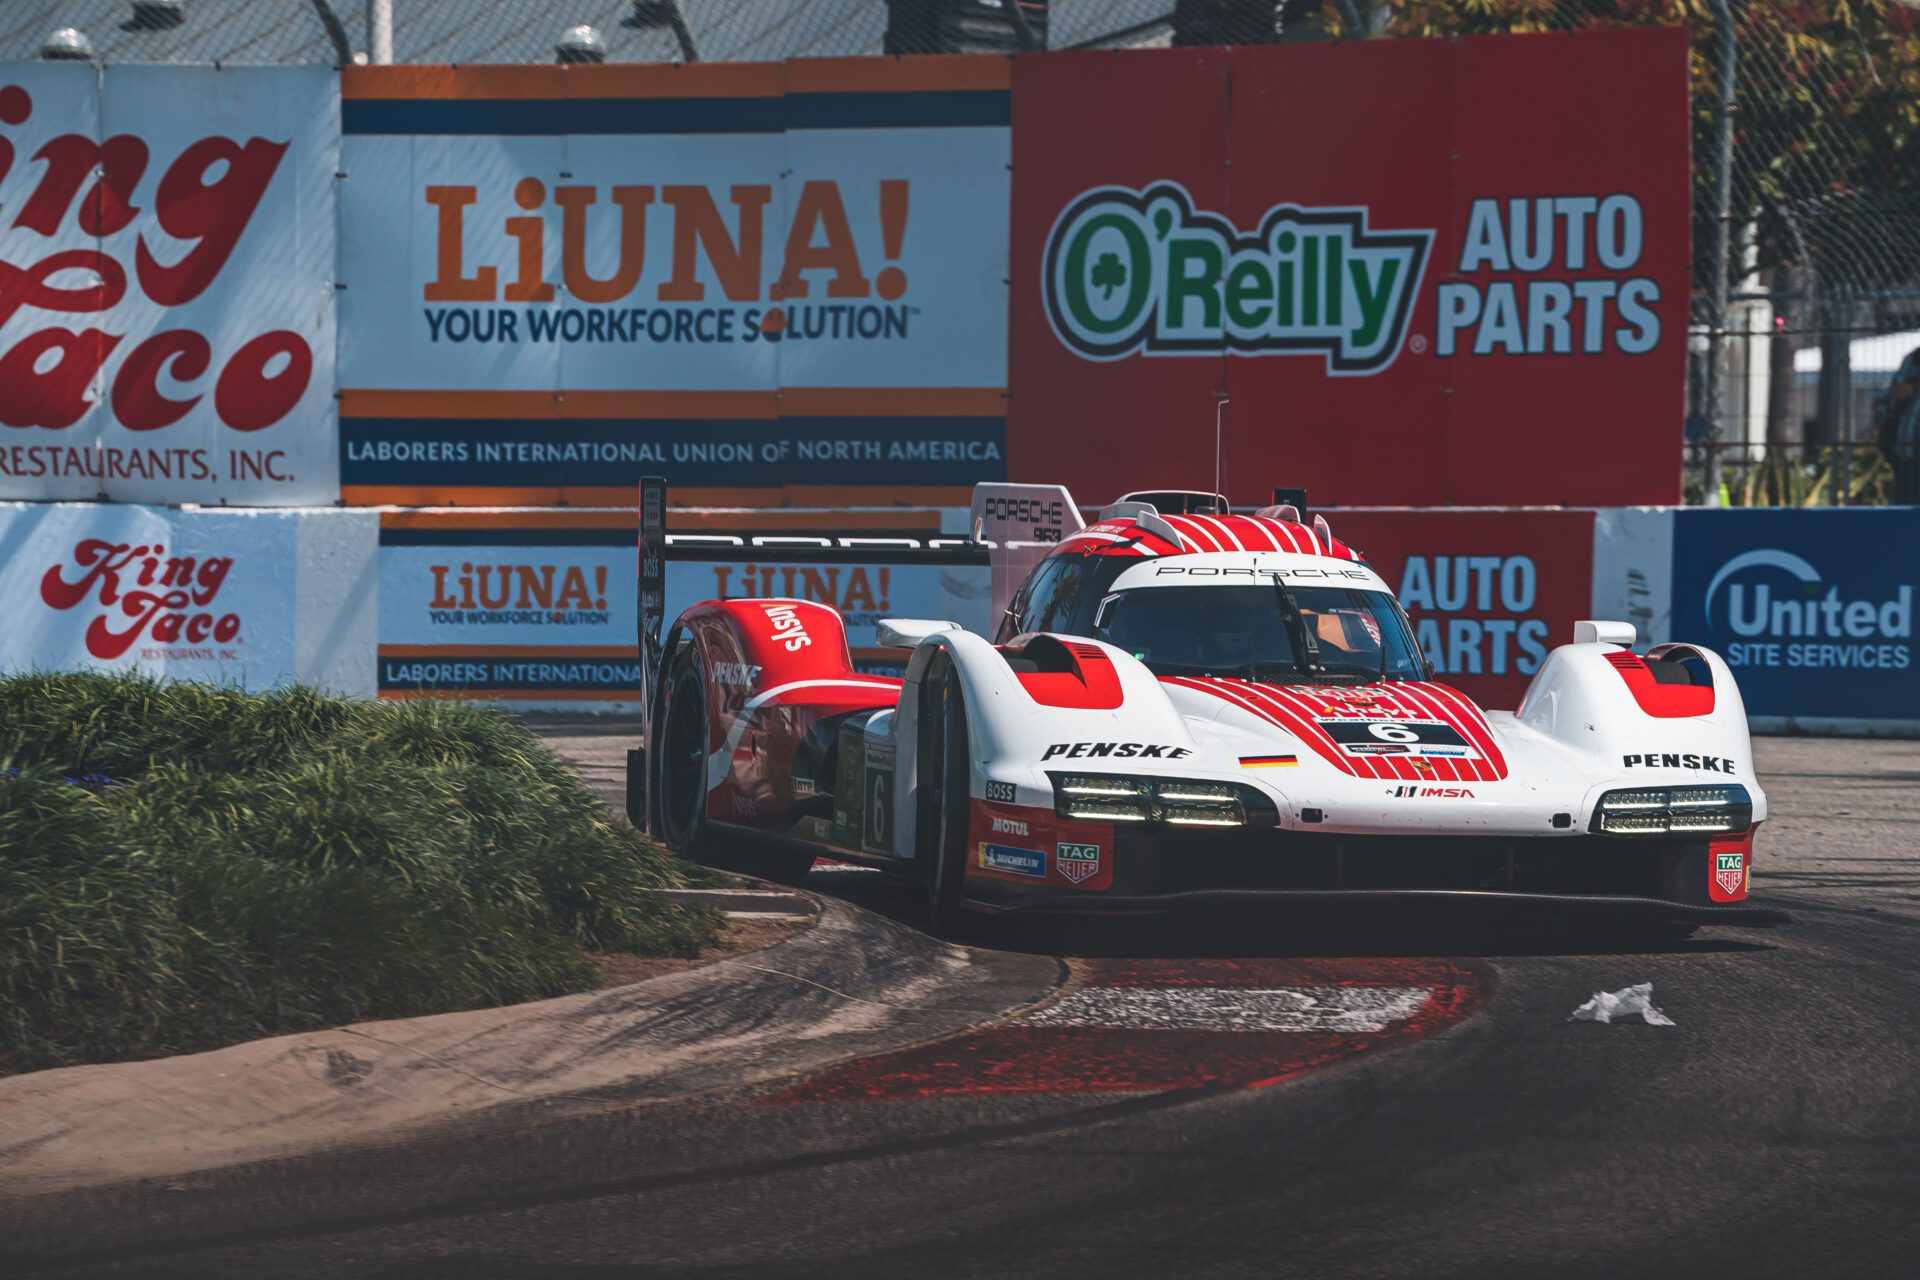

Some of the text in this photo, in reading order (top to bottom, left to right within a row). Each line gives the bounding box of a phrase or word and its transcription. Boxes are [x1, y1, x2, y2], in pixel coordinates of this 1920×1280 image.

[0, 85, 292, 307] ing
[423, 176, 910, 304] LiUNA!
[1460, 194, 1643, 273] AUTO
[1060, 203, 1404, 351] O'Reilly
[423, 308, 519, 344] YOUR
[526, 307, 735, 344] WORKFORCE
[1436, 278, 1662, 357] PARTS
[347, 440, 1001, 463] LABORERS INTERNATIONAL UNION OF NORTH AMERICA
[230, 449, 295, 482] INC.
[985, 497, 1063, 526] PORSCHE
[1033, 526, 1063, 543] 963
[40, 538, 236, 611] King
[429, 561, 609, 611] LiUNA!
[1155, 566, 1371, 582] PORSCHE
[1399, 555, 1537, 613] AUTO
[429, 611, 466, 625] YOUR
[466, 611, 544, 625] WORKFORCE
[1728, 583, 1913, 638] United
[85, 590, 242, 660] Taco
[1416, 617, 1550, 677] ARTS
[1728, 643, 1911, 669] SITE SERVICES
[387, 663, 641, 684] LABORERS INTERNATIONA
[1367, 722, 1420, 743] 6
[1039, 742, 1194, 762] PENSKE
[1622, 753, 1736, 775] PENSKE
[987, 783, 1014, 800] BOSS
[1420, 787, 1475, 799] IMSA
[873, 773, 885, 844] 6
[992, 817, 1029, 837] MOTUL
[996, 853, 1040, 869] MICHELIN
[1060, 845, 1096, 859] TAG
[1718, 856, 1742, 869] TAG
[1058, 860, 1096, 881] HEUER
[1718, 871, 1742, 892] HEUER
